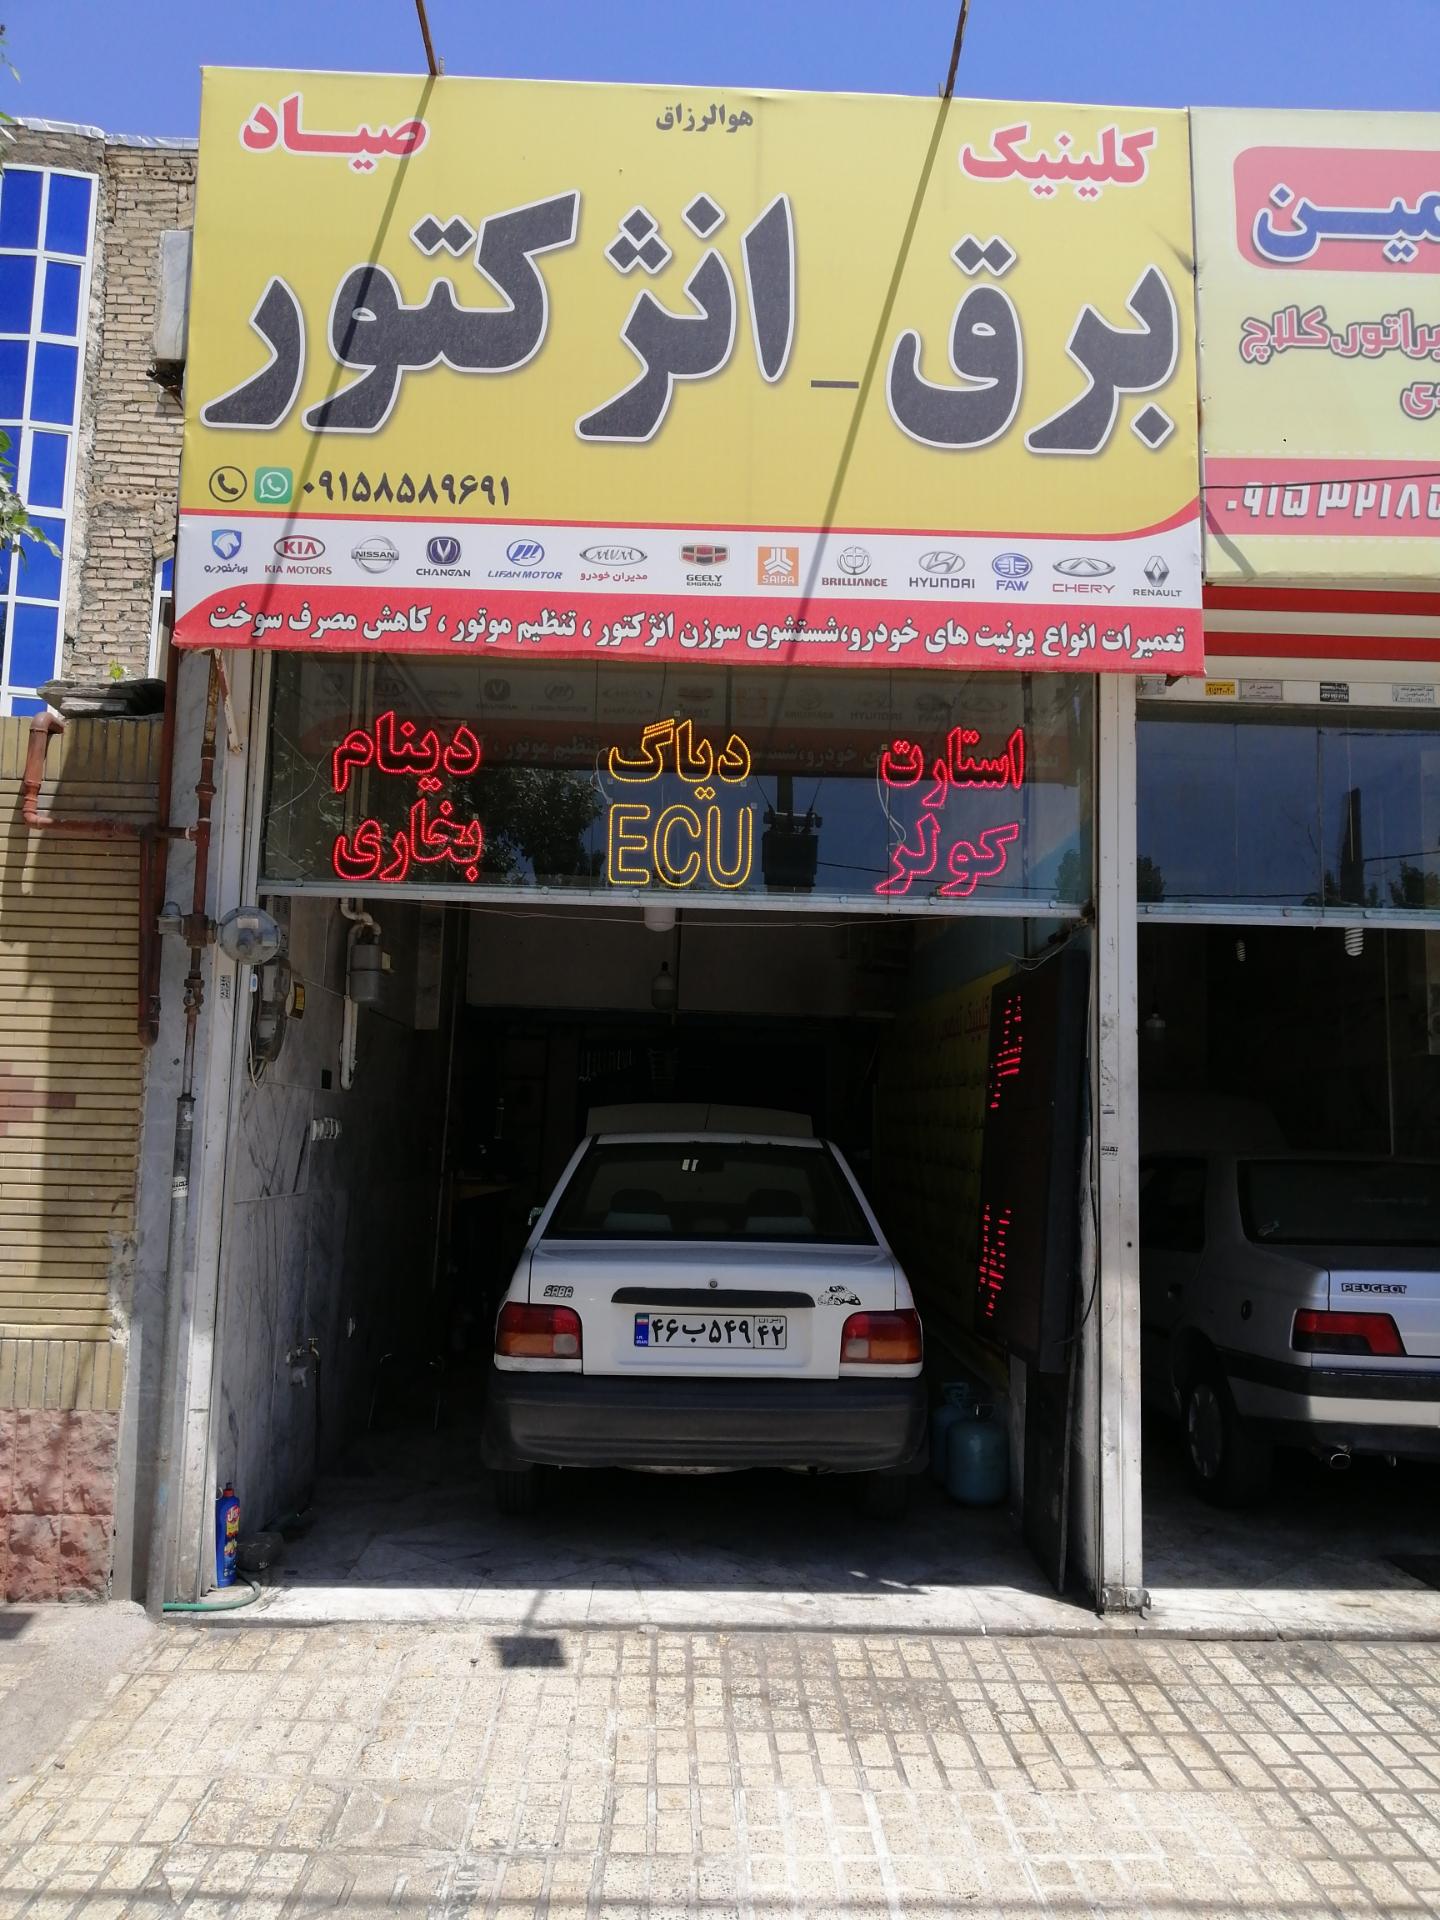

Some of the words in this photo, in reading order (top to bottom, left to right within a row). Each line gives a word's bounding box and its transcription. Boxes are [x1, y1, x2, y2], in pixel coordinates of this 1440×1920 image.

[240, 92, 428, 173] صیاد
[960, 121, 1157, 198] کلینیک
[886, 235, 1179, 455] برق
[303, 470, 510, 506] ۰۹۱۵۸۵۸۹۶۹۱
[283, 540, 317, 555] KIA
[355, 550, 395, 558] NISSAN
[264, 564, 283, 574] KIA
[286, 565, 332, 575] MOTORS
[415, 568, 471, 577] CHANGAN
[487, 569, 520, 578] LIFAN
[521, 570, 562, 579] MOTOR
[579, 571, 611, 581] خودرو
[612, 571, 648, 583] مدیران
[761, 574, 795, 584] SAIPA
[821, 577, 888, 587] BRILLIANCE
[908, 576, 975, 589] HYUNDAI
[996, 579, 1029, 591] FAW
[1052, 583, 1115, 593] CHERY
[1132, 588, 1182, 597] RENAULT
[208, 601, 283, 638] سوخت
[288, 601, 358, 639] مصرف
[362, 604, 432, 640] کاهش
[451, 607, 513, 643] موتور
[517, 608, 577, 643] تنظیم
[679, 618, 742, 649] سوزن
[925, 618, 969, 653] های
[975, 621, 1035, 657] یونیت
[1041, 622, 1096, 657] انواع
[1101, 624, 1186, 659] تعمیرات
[332, 709, 481, 793] دینام
[608, 717, 752, 800] دیاگ
[880, 725, 1026, 808] استارت
[332, 797, 484, 884] بخاری
[608, 803, 753, 889] ECU
[874, 811, 1020, 897] کولر
[1341, 1282, 1407, 1294] PEUGEOT
